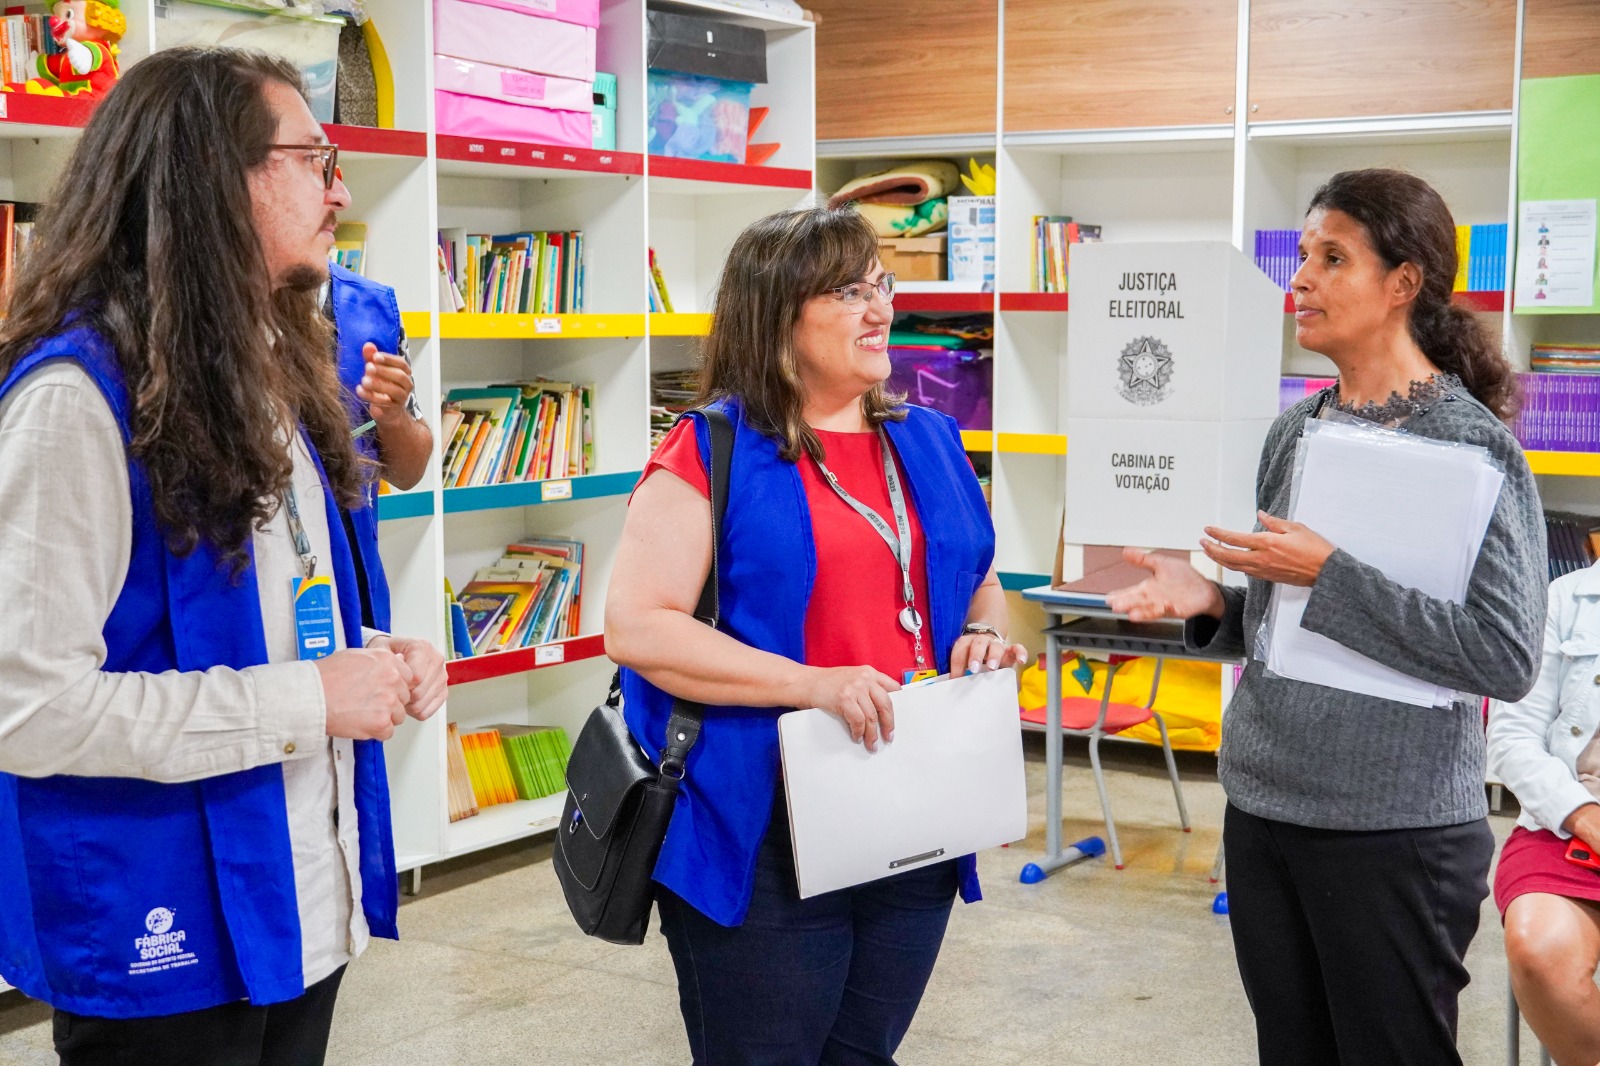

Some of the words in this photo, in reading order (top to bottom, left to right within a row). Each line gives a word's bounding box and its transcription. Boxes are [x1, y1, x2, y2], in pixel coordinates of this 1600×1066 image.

[1118, 272, 1177, 295] JUSTIÇA
[1108, 300, 1184, 319] ELEITORAL
[1111, 453, 1155, 470] CABINA
[1158, 456, 1175, 470] DE
[1115, 473, 1170, 494] VOTAÇÃO
[866, 512, 885, 531] SEEDF
[135, 930, 186, 949] FÁBRICA
[140, 942, 183, 960] SOCIAL
[170, 959, 198, 967] TRABALHO
